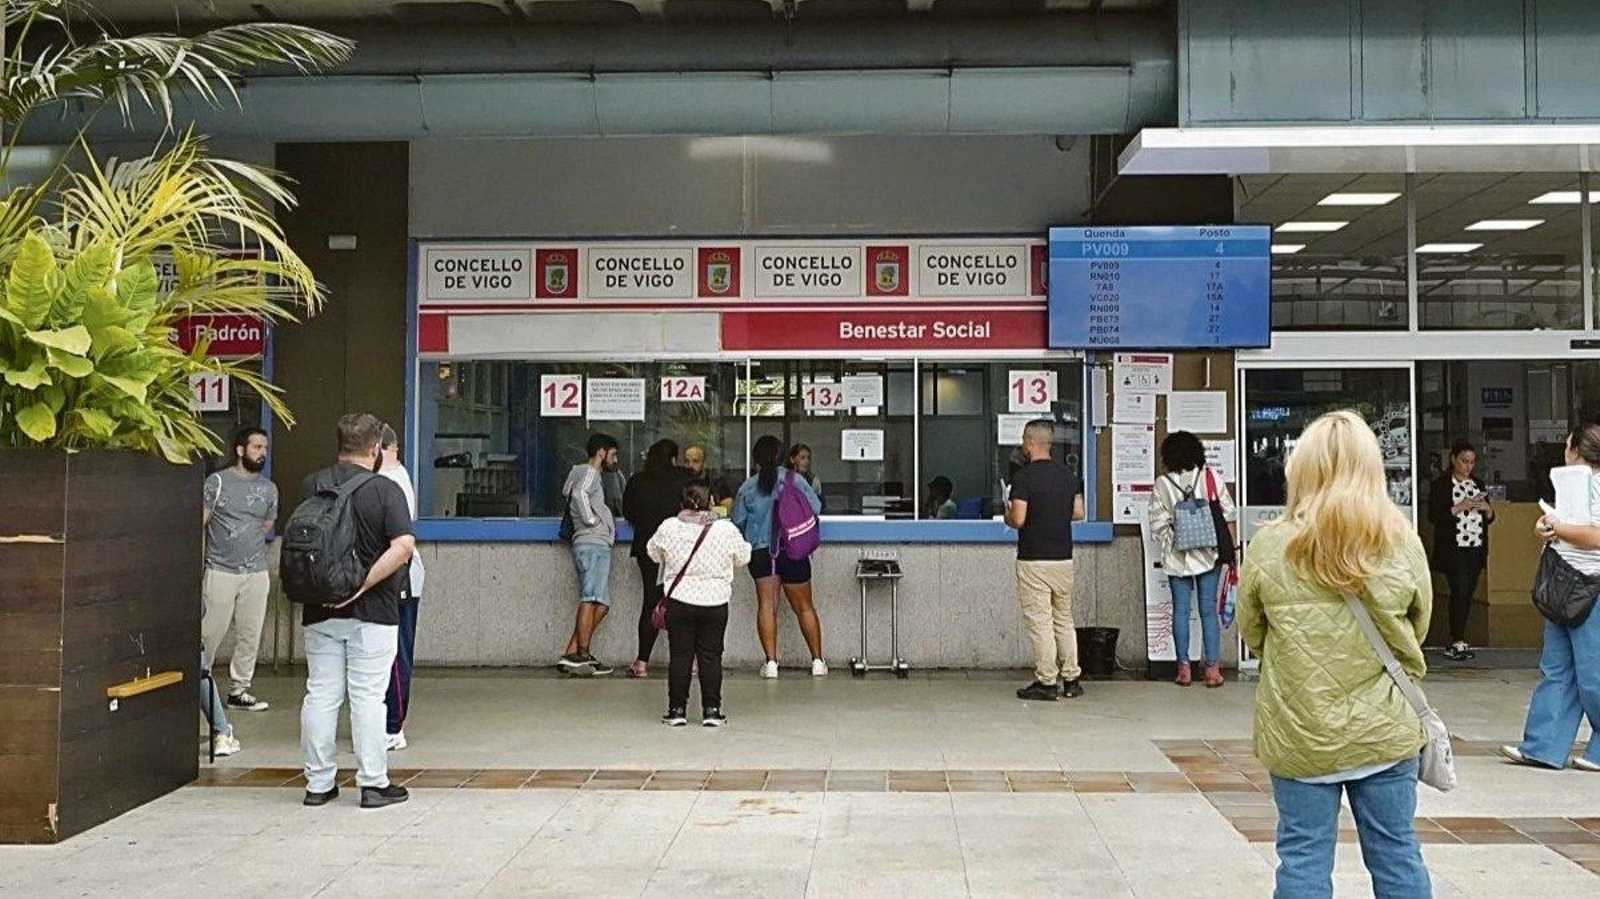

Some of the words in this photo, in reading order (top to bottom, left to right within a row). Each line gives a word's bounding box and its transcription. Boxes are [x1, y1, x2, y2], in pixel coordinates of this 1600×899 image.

[1084, 229, 1125, 239] Quenda
[1199, 228, 1230, 238] Posto
[1082, 242, 1129, 256] PV009
[1215, 242, 1225, 255] 4
[434, 258, 523, 273] CONCELLO
[595, 257, 685, 272] CONCELLO
[762, 256, 853, 271] CONCELLO
[926, 254, 1018, 270] CONCELLO
[444, 275, 466, 289] DE
[471, 275, 513, 289] VIGO
[605, 274, 628, 288] DE
[633, 274, 674, 288] VIGO
[773, 273, 795, 287] DE
[800, 272, 843, 287] VIGO
[937, 272, 960, 286] DE
[965, 271, 1008, 286] VIGO
[195, 324, 260, 341] Padrón
[839, 321, 927, 339] Benestar
[932, 320, 991, 339] Social
[194, 377, 224, 404] 11
[543, 382, 579, 409] 12
[662, 378, 703, 399] 12A
[1012, 378, 1048, 405] 13
[805, 387, 843, 407] 13A
